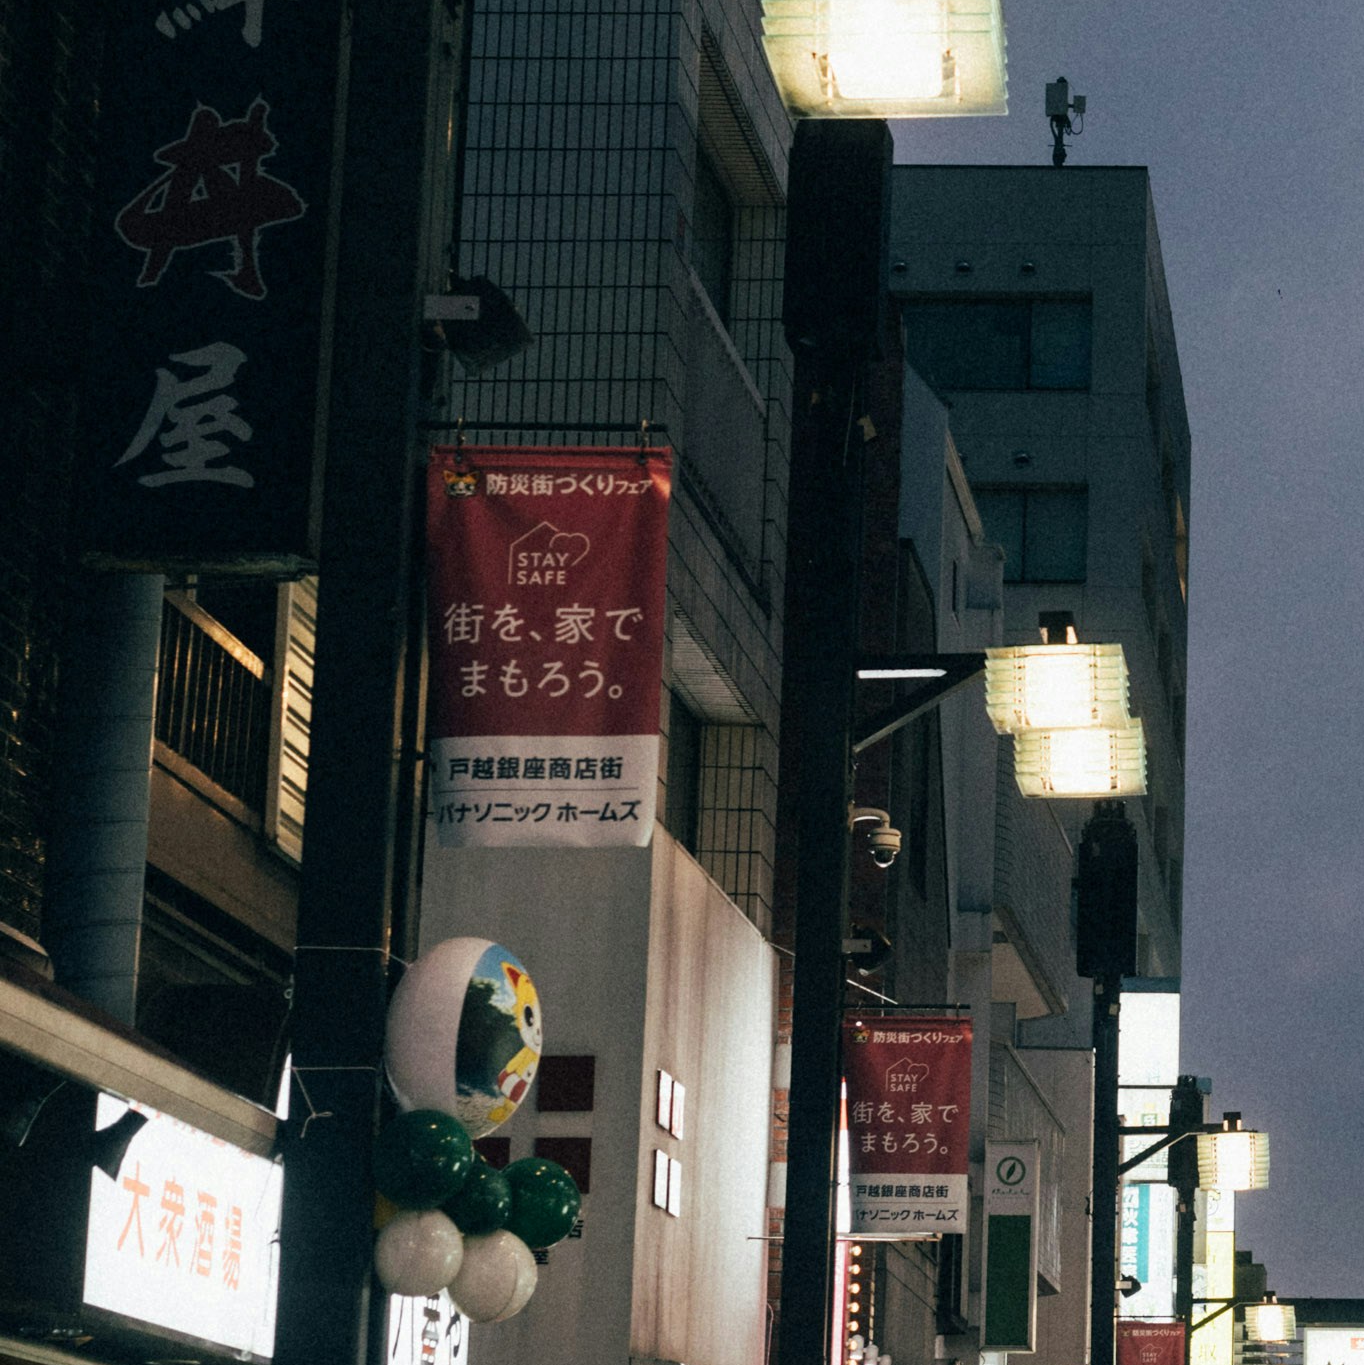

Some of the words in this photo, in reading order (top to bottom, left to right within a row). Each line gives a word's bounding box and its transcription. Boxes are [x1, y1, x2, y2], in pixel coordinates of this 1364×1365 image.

[486, 472, 653, 496] 防災街づくりフェア
[518, 553, 570, 567] STAY
[517, 570, 567, 585] SAFE
[443, 603, 643, 646] 街を、家で
[460, 660, 624, 699] まもろう。
[448, 757, 624, 780] 戸越銀座商店街
[556, 800, 641, 823] ホームズ
[872, 1031, 964, 1044] 防災街づくりフェア
[890, 1074, 918, 1083] STAY
[890, 1083, 917, 1093] SAFE
[852, 1101, 960, 1125] 街を、家で
[861, 1132, 948, 1154] まもろう。
[856, 1185, 949, 1198] 戸越銀座商店街
[117, 1159, 243, 1291] 大衆酒場
